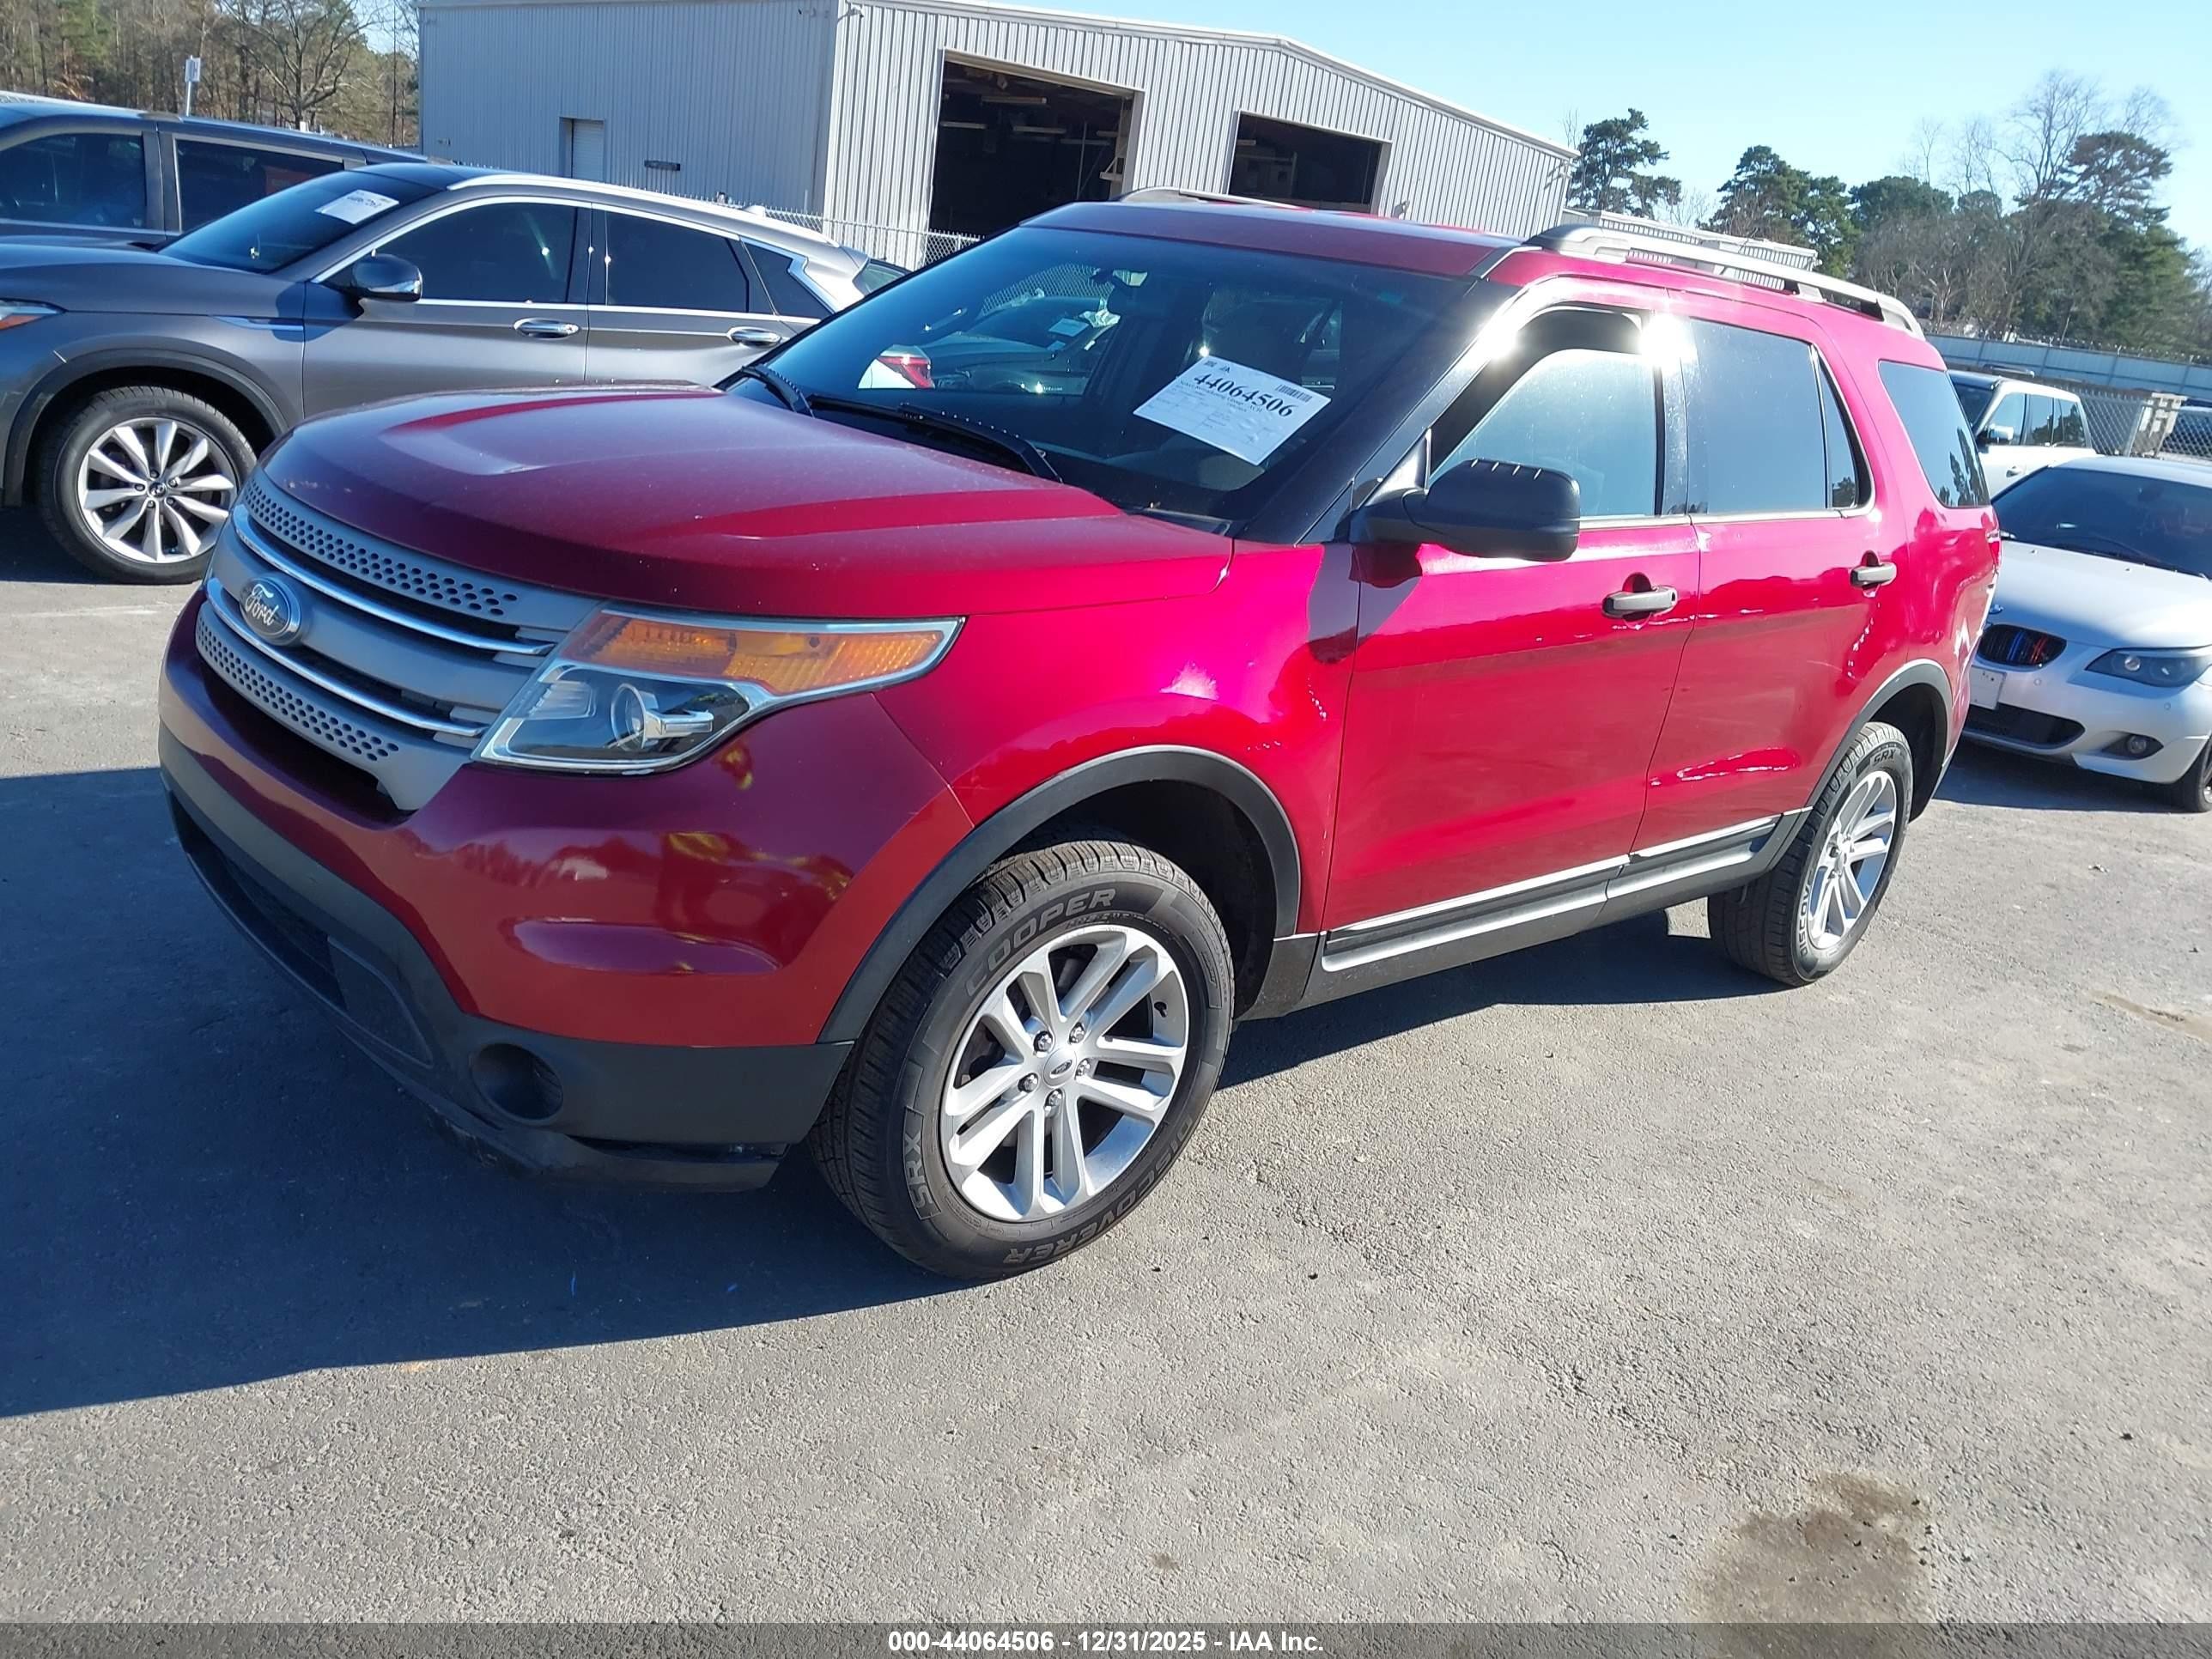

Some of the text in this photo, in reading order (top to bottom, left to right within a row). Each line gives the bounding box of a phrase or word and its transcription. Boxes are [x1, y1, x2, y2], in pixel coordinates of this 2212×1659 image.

[1194, 374, 1294, 417] 44064506
[246, 584, 279, 625] Ford
[1874, 749, 1896, 763] SRX
[964, 888, 1117, 998] COOPER
[903, 1112, 935, 1217] SRX
[1002, 1113, 1197, 1266] DISCOVERER
